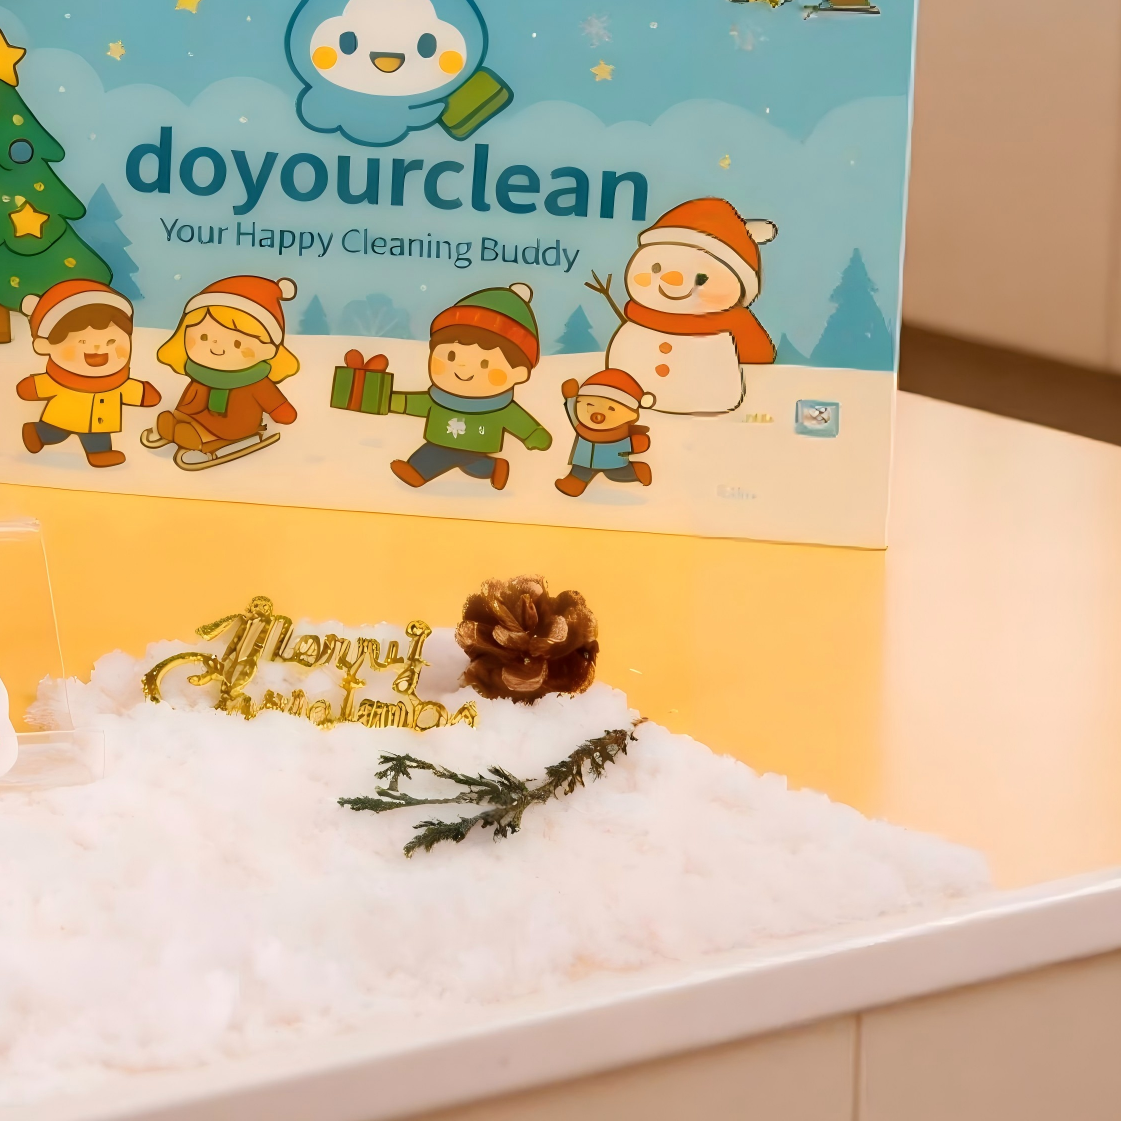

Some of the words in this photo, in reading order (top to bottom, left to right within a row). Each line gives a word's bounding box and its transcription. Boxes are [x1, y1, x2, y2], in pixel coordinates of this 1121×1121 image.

[125, 125, 649, 222] doyourclean
[159, 217, 228, 246] Your
[235, 222, 333, 258] Happy
[340, 228, 472, 269] Cleaning
[479, 237, 580, 272] Buddy
